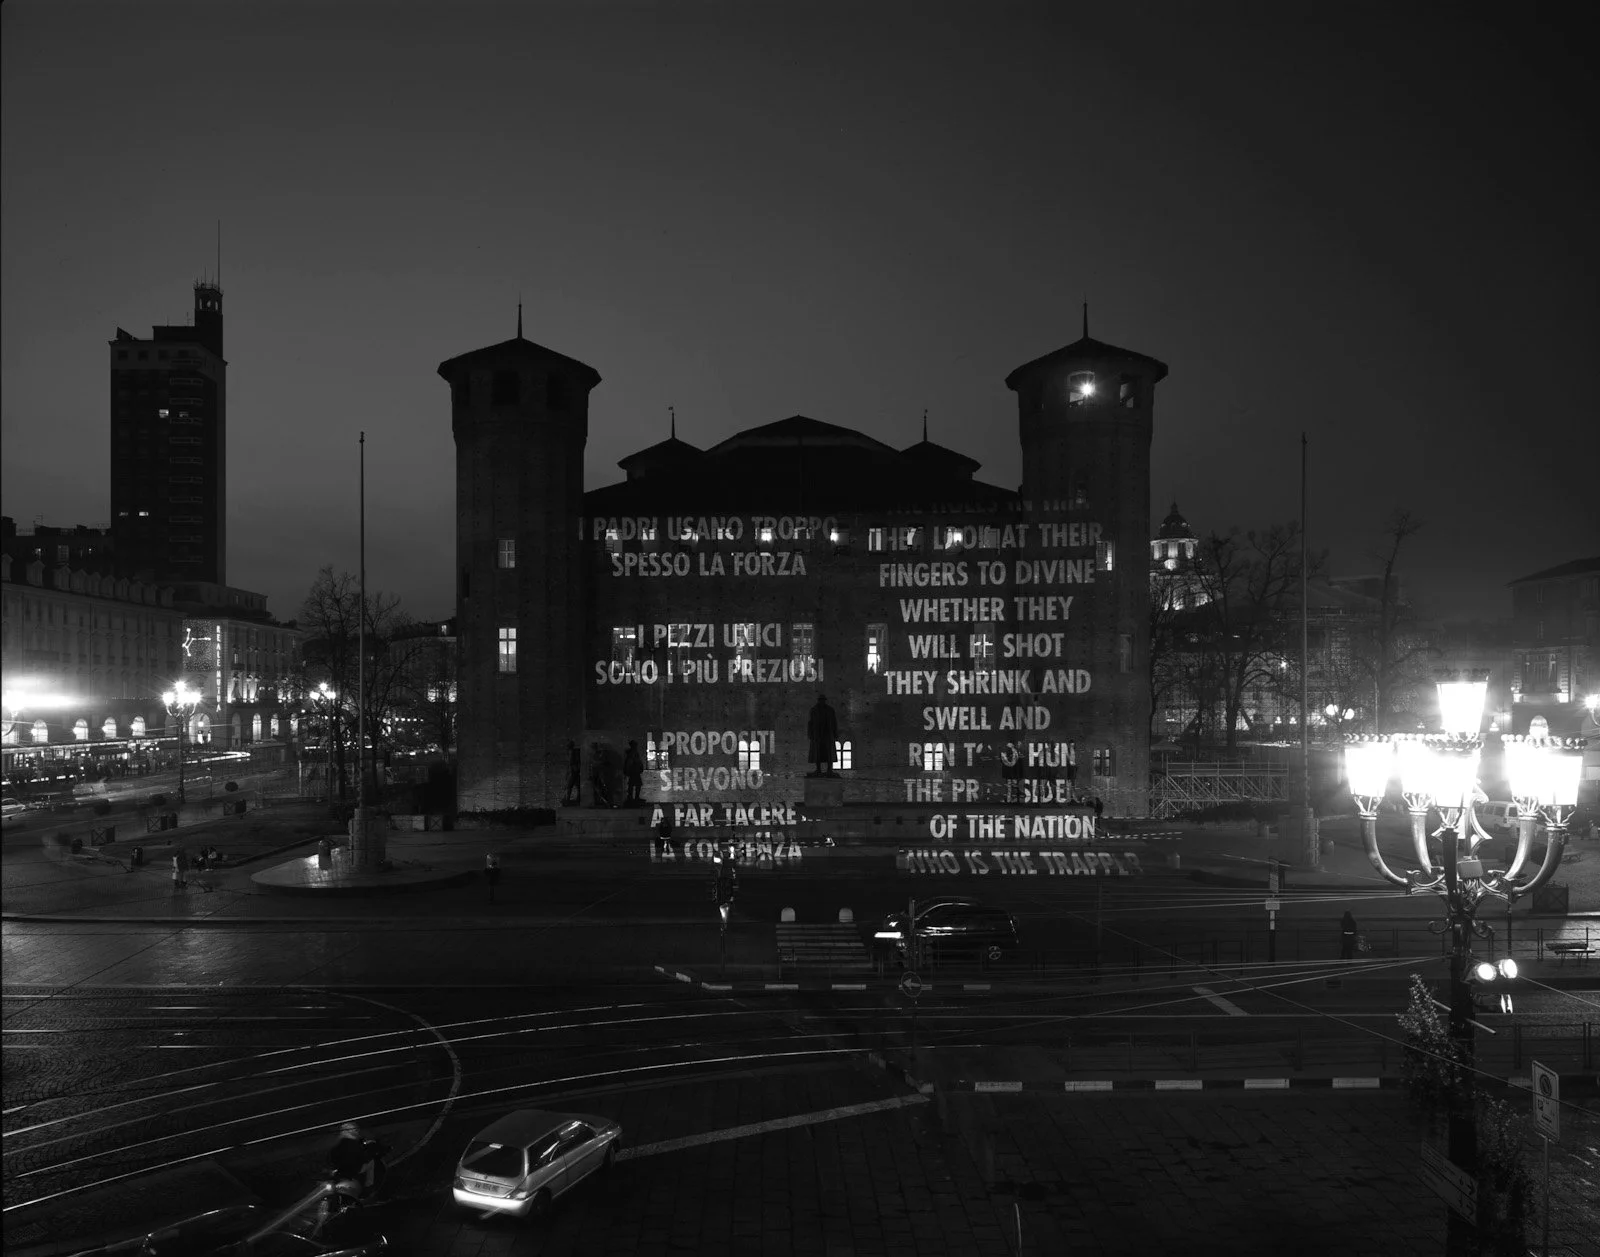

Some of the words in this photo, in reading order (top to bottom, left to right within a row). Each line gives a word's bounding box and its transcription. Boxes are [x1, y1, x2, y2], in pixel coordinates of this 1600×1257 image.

[593, 517, 659, 541] PADRI
[667, 517, 744, 541] USANO
[751, 516, 838, 541] TROPPO
[1001, 524, 1029, 549] AT
[1038, 522, 1103, 547] THEIR
[611, 552, 690, 577] SPESSO
[699, 552, 726, 576] LA
[733, 552, 807, 576] FORZA
[879, 562, 969, 588] FINGERS
[977, 561, 1006, 586] TO
[1015, 559, 1095, 585] DIVINE
[900, 597, 1005, 623] WHETHER
[1014, 596, 1074, 621] THEY
[638, 624, 644, 648] I
[653, 623, 715, 648] PEZZI
[723, 623, 782, 647] UNICI
[908, 634, 960, 659] WILL
[969, 634, 992, 658] B
[1002, 633, 1065, 658] SHOT
[595, 660, 658, 685] SONO
[682, 653, 719, 684] PIÙ
[727, 658, 824, 684] PREZIOSI
[885, 670, 939, 695] THEY
[946, 669, 1032, 694] SHRINK
[1041, 669, 1092, 694] AND
[922, 706, 992, 731] SWELL
[999, 706, 1051, 730] AND
[909, 742, 955, 767] RN
[660, 766, 764, 791] SERVONO
[903, 778, 944, 802] THE
[650, 803, 665, 827] A
[674, 802, 715, 827] FAR
[721, 801, 797, 827] TACERE
[929, 814, 958, 839] OF
[966, 814, 1006, 839] THE
[1014, 814, 1096, 839] NATION
[964, 850, 990, 875] IS
[991, 851, 1038, 875] THE
